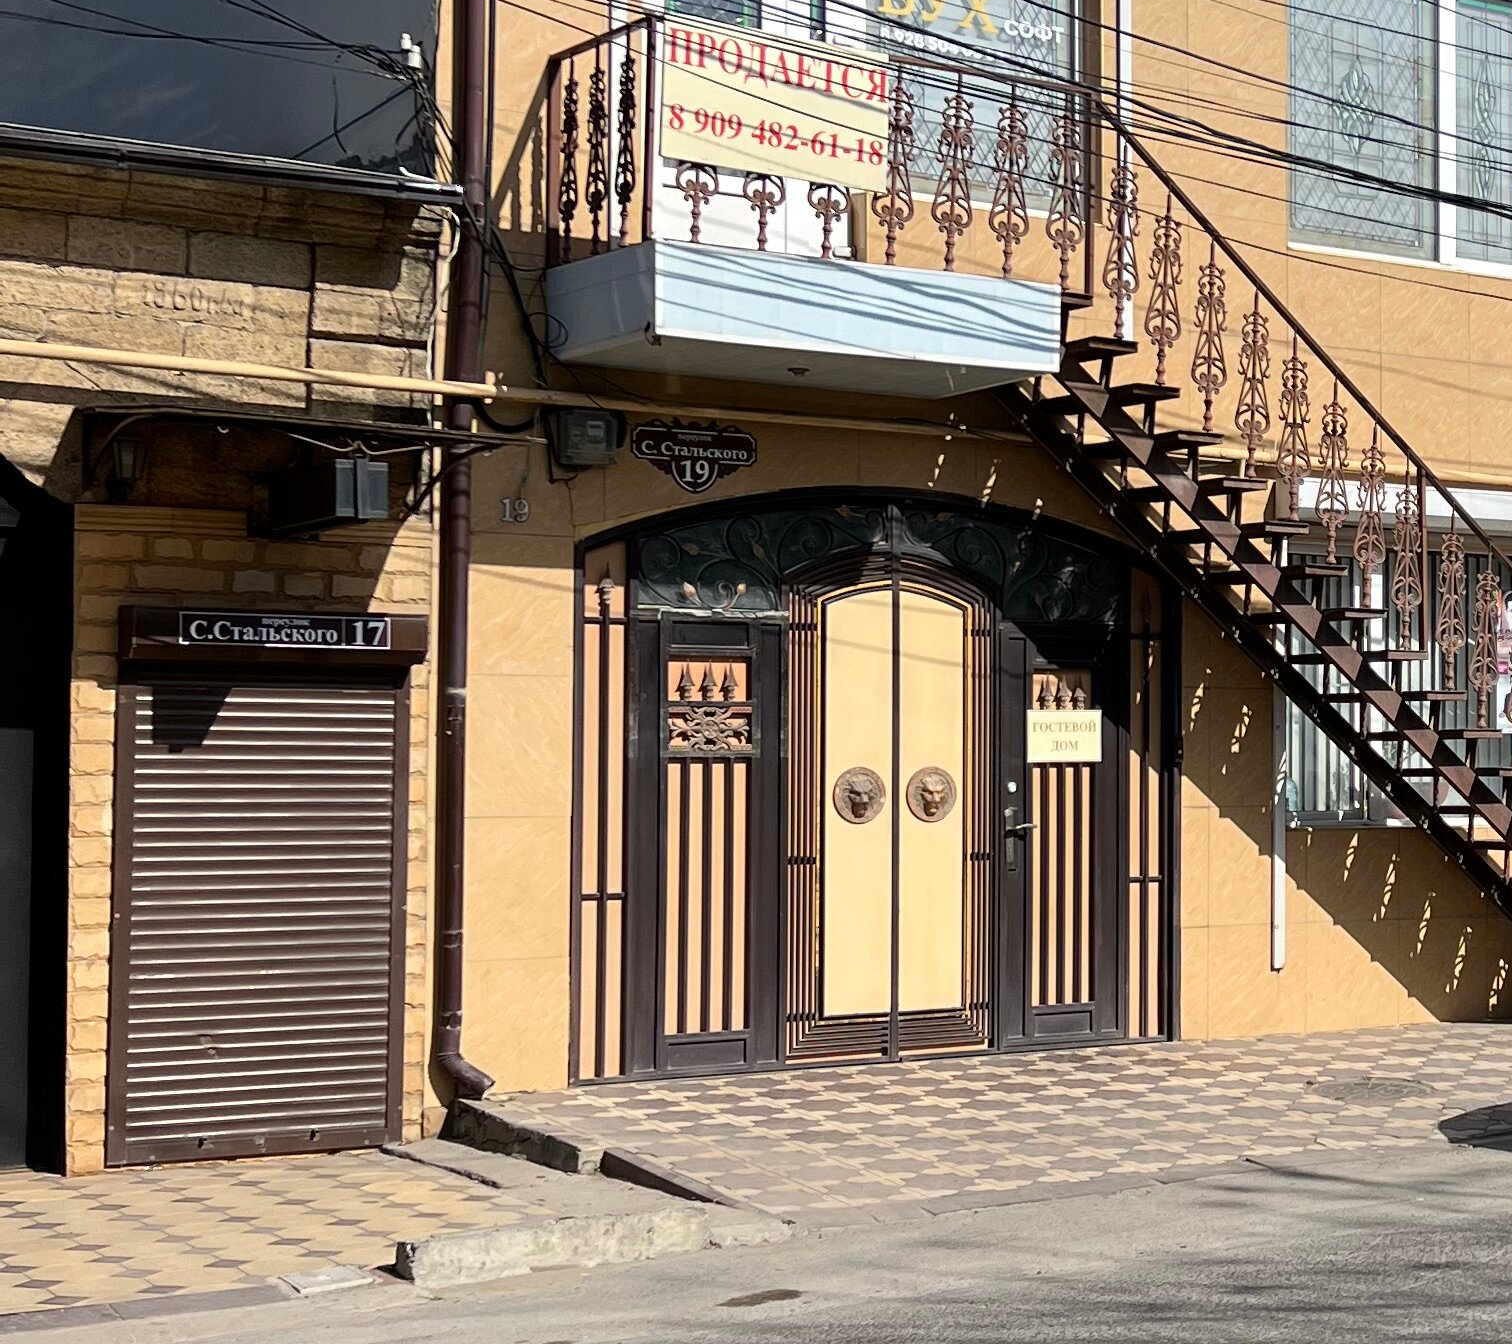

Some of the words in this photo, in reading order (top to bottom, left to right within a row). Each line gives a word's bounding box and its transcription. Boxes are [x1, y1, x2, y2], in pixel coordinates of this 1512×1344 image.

[669, 27, 888, 103] ПРОДАЕТСЯ
[669, 103, 685, 130] 8
[694, 108, 743, 139] 909
[752, 119, 884, 166] 482-61-18
[641, 440, 657, 454] С.
[661, 441, 748, 460] Стальского
[680, 460, 709, 483] 19
[501, 497, 530, 523] 19
[351, 620, 386, 646] 17
[1032, 720, 1096, 733] ГОСТЕВОЙ
[1051, 740, 1079, 752] ДОМ
